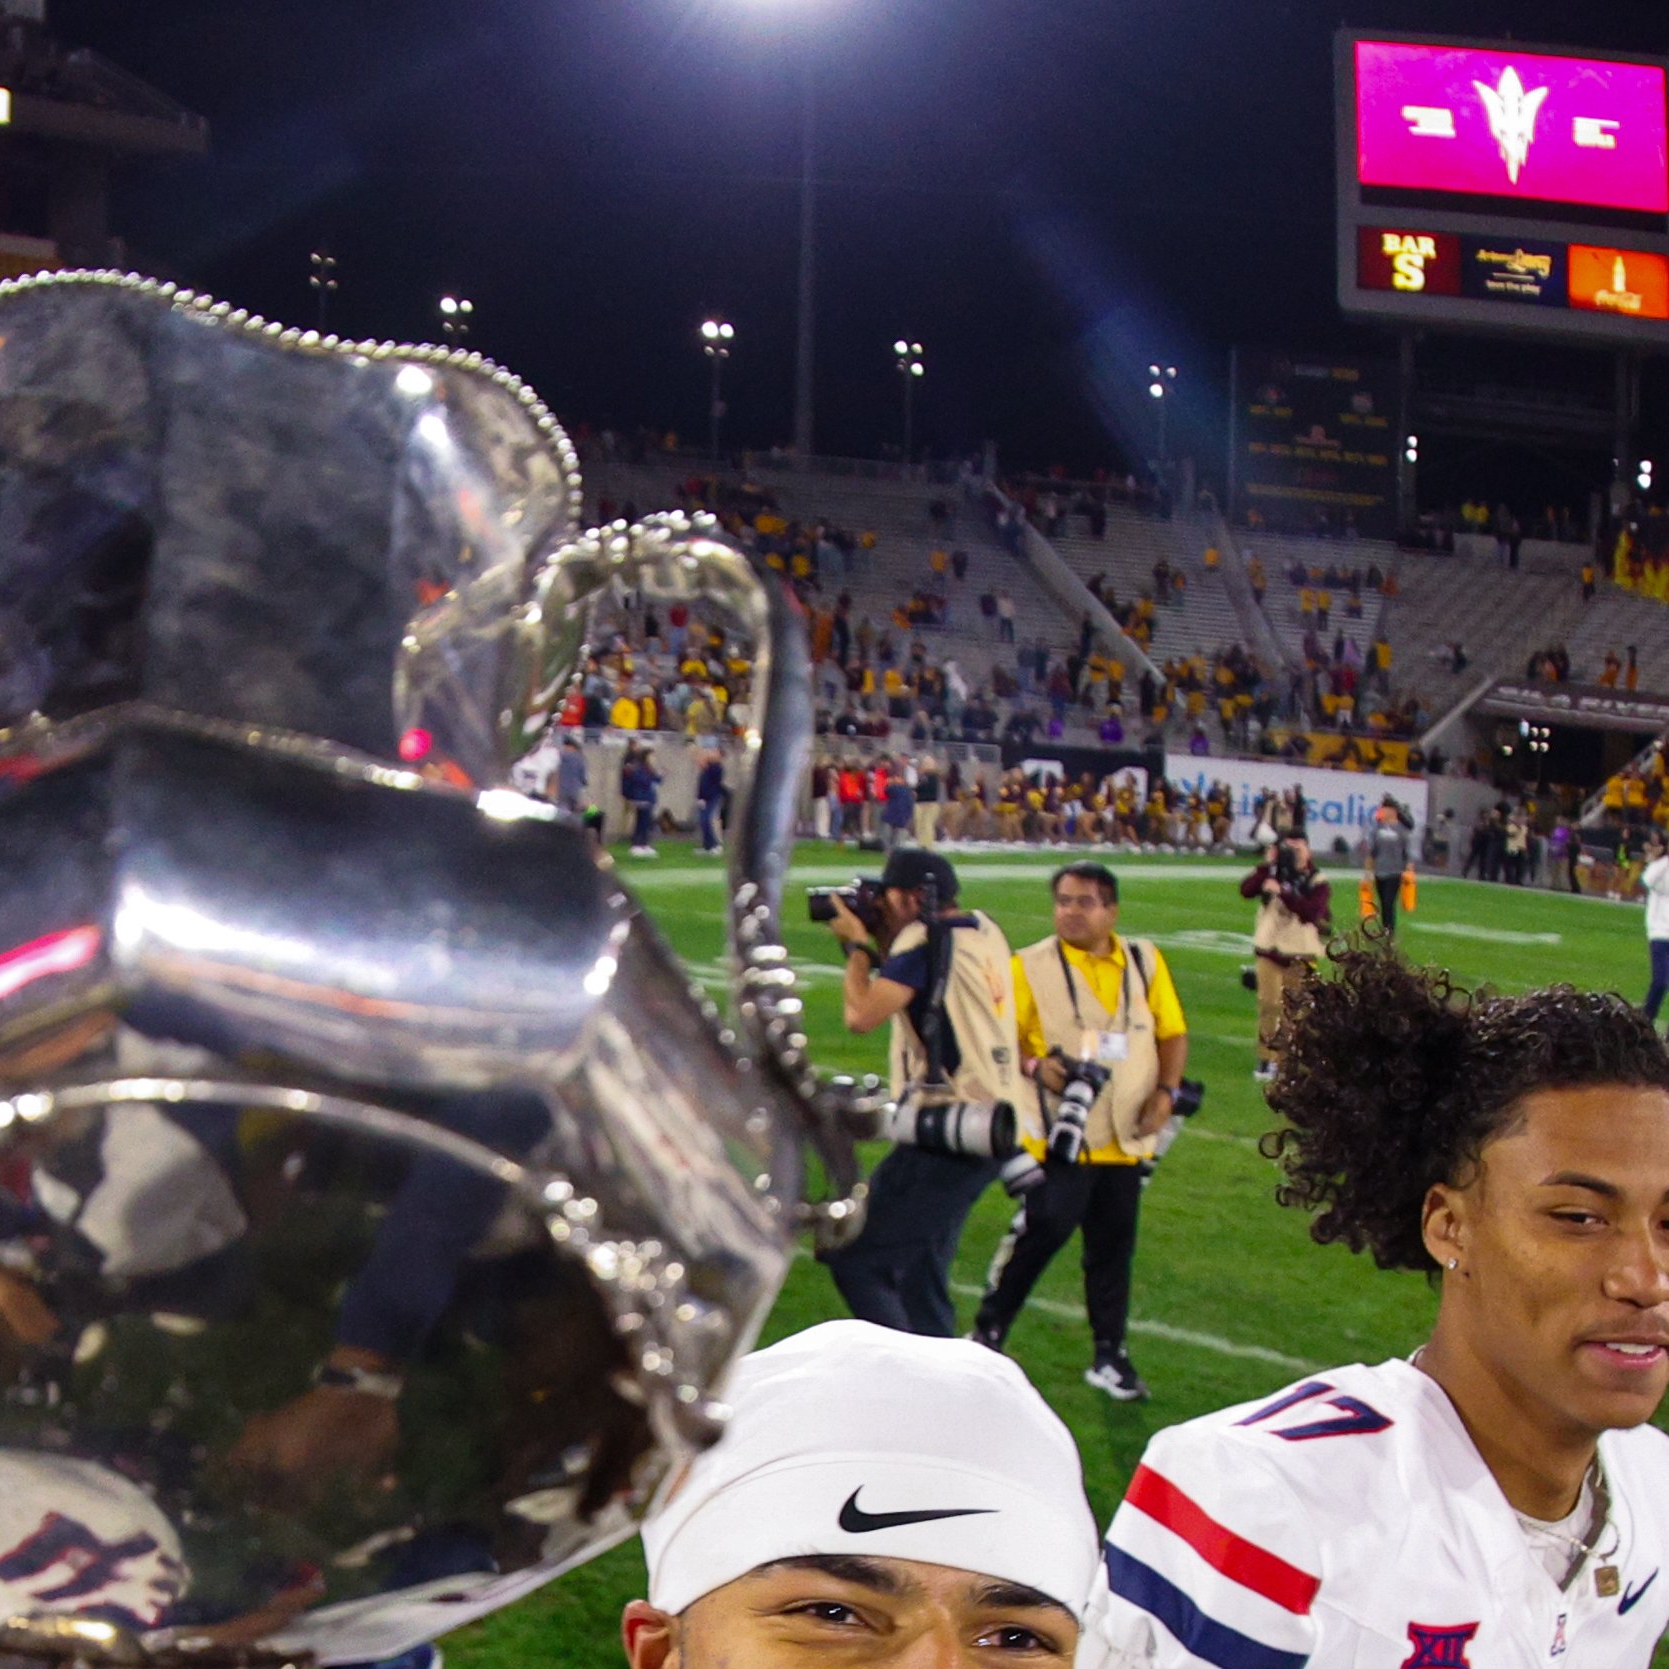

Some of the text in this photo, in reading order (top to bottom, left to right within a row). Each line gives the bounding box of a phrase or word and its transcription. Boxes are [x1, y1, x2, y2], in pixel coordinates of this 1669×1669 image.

[1382, 233, 1437, 259] BAR
[1391, 253, 1426, 291] S
[1228, 1381, 1396, 1442] 17
